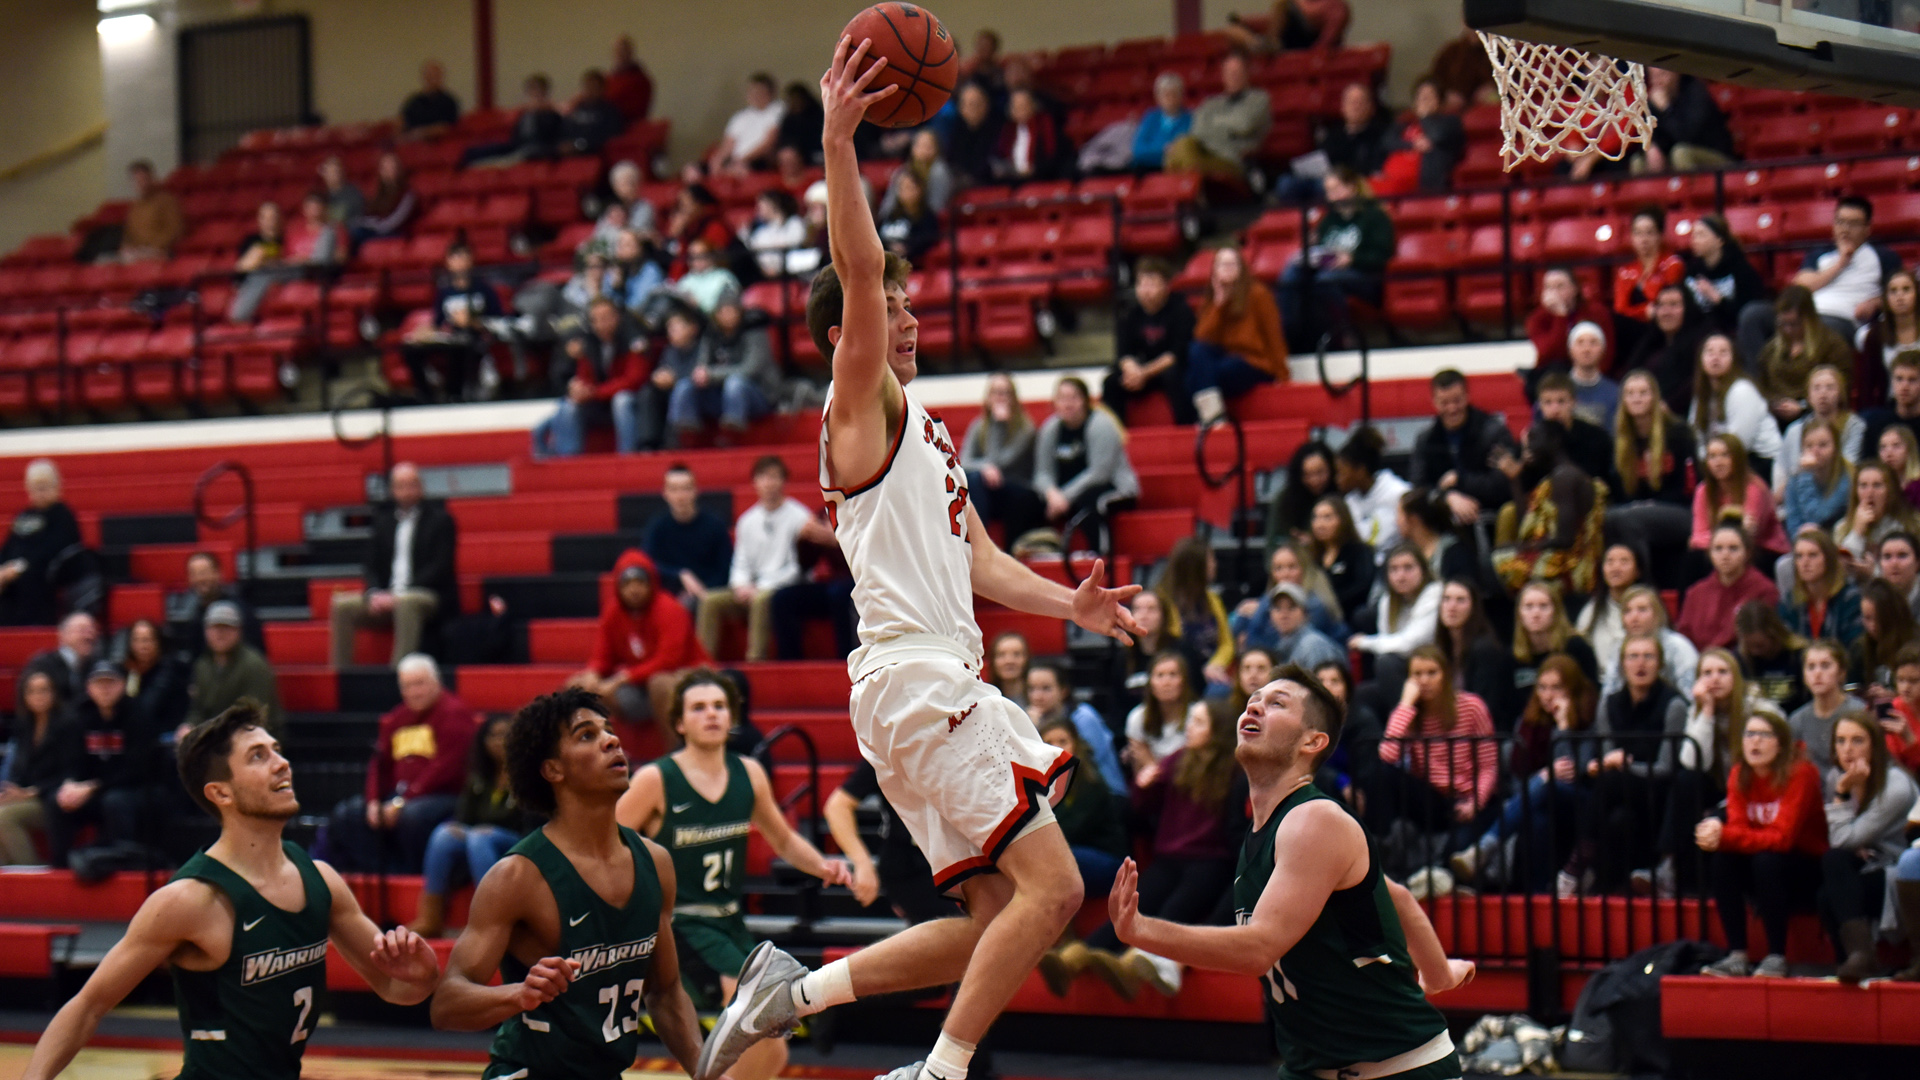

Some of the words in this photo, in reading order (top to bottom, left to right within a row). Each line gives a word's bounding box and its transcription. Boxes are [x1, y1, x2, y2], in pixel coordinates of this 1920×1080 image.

[702, 848, 734, 892] 21
[242, 939, 327, 985] WARRIO
[571, 933, 658, 981] WARRIOR
[290, 985, 312, 1045] 2
[598, 978, 645, 1043] 23
